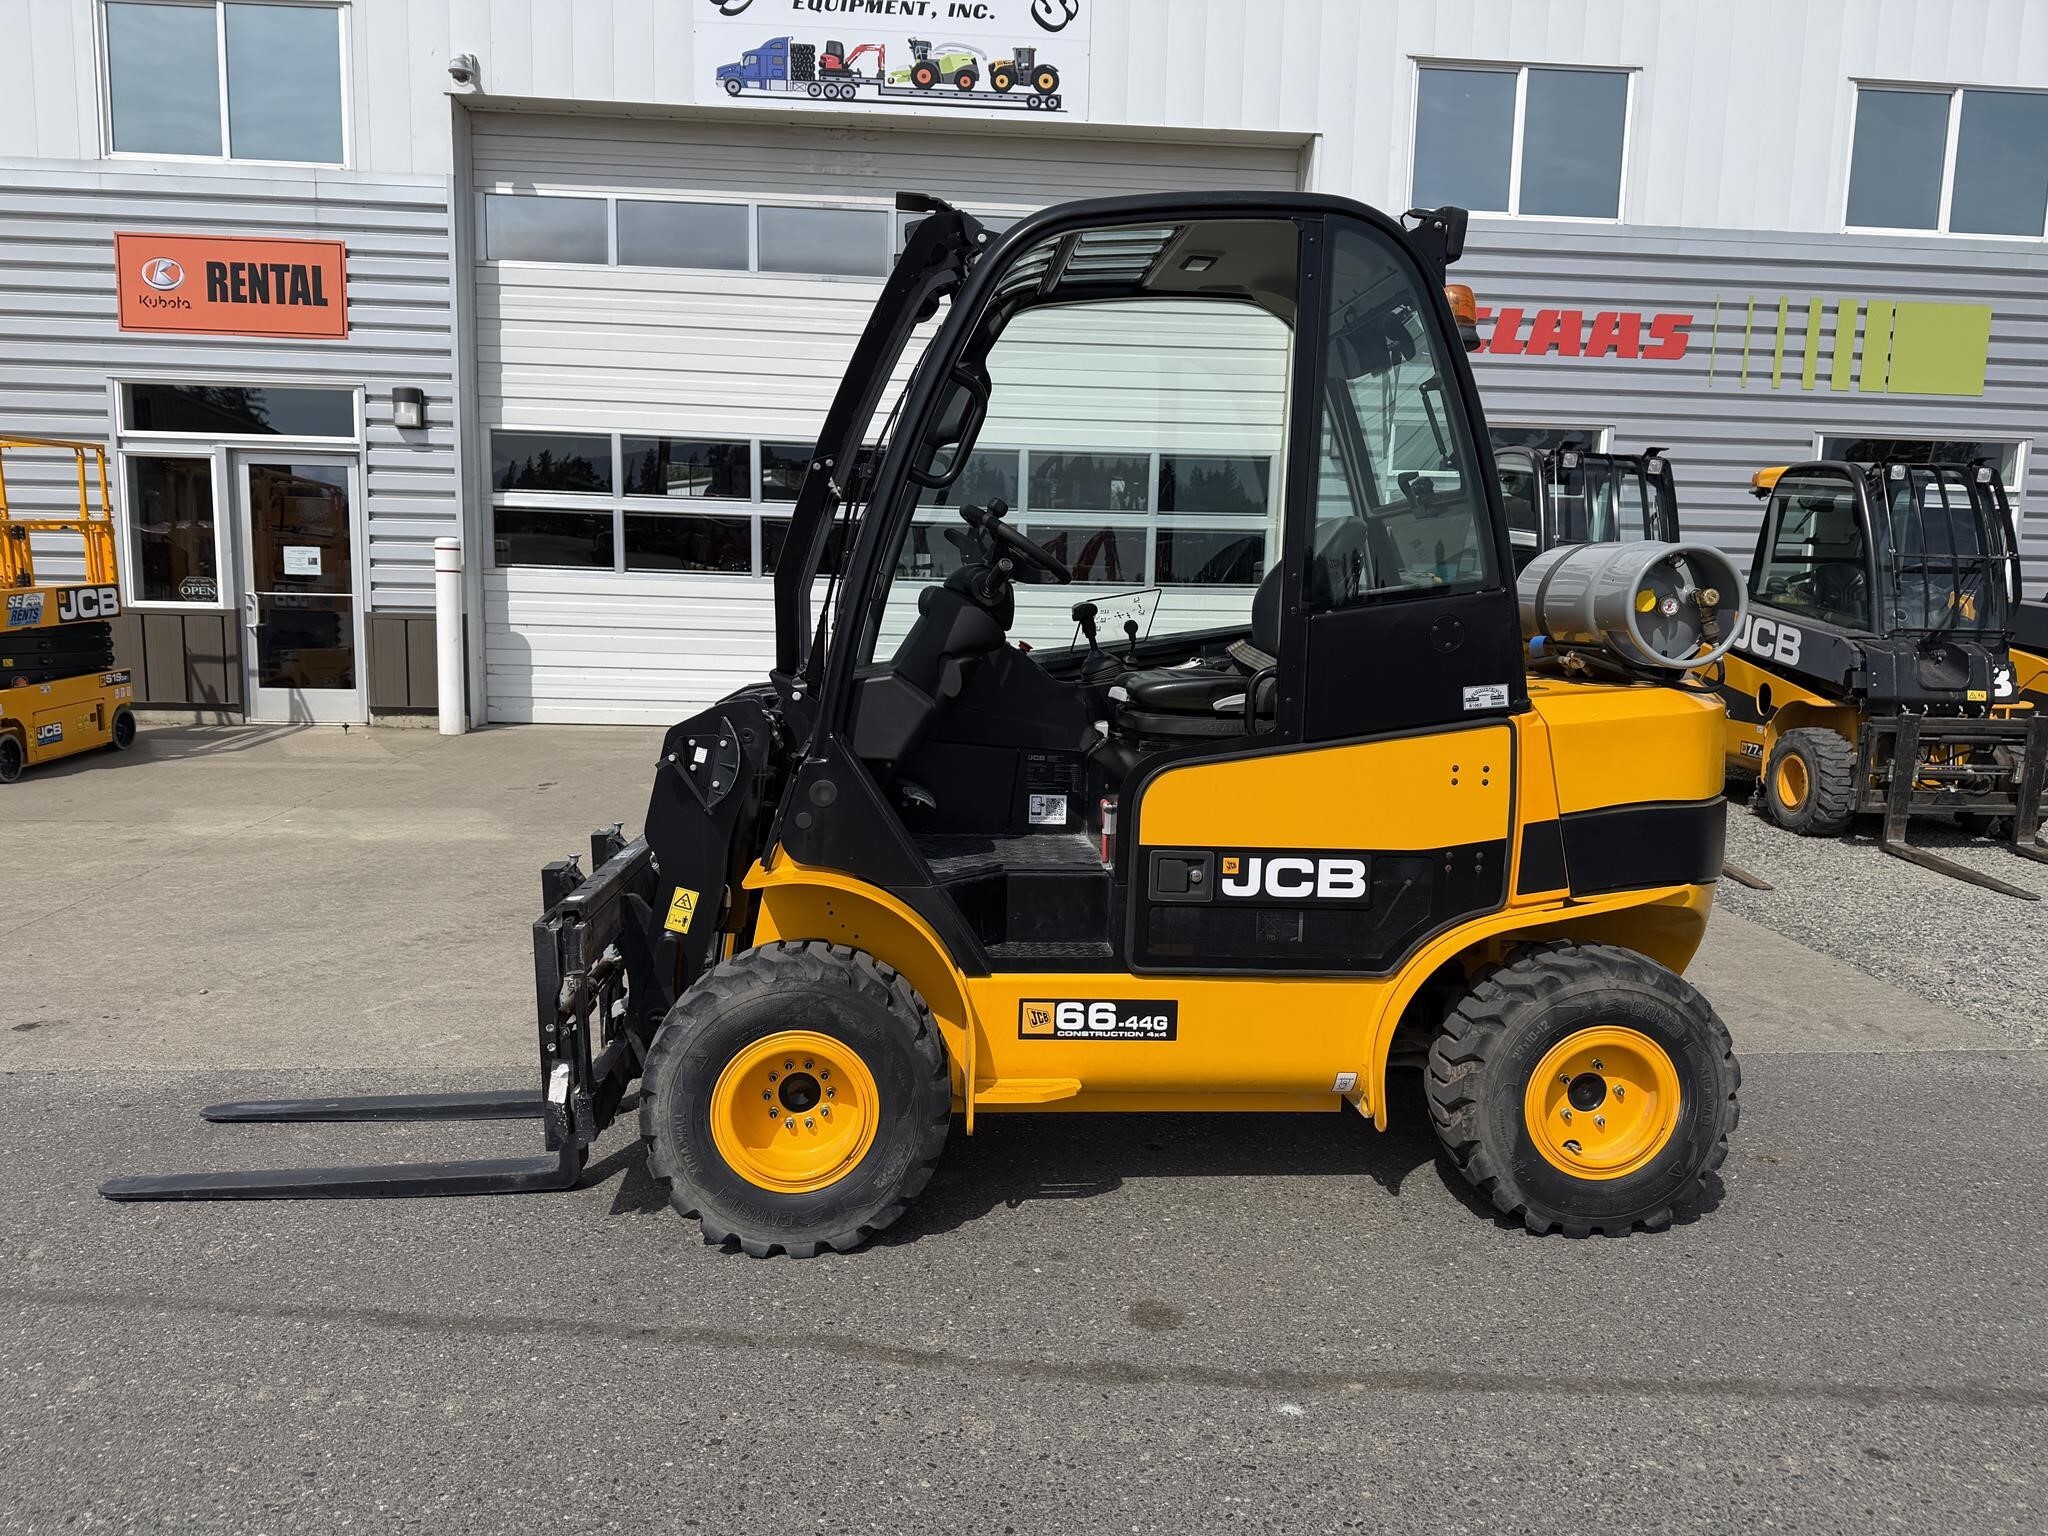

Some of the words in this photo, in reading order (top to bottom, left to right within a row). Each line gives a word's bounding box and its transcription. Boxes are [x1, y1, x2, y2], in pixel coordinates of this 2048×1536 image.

[948, 3, 995, 20] INC.
[206, 261, 328, 306] RENTAL
[139, 295, 191, 309] Kubota
[181, 586, 216, 595] OPEN
[60, 588, 119, 620] JCB
[11, 608, 39, 622] RENTS
[1733, 614, 1802, 666] JCB
[37, 723, 62, 739] JCB
[1222, 858, 1366, 898] JCB
[1030, 1009, 1050, 1026] JCB
[1056, 1002, 1168, 1031] 66-44G
[1057, 1030, 1143, 1038] CONSTRUCTION
